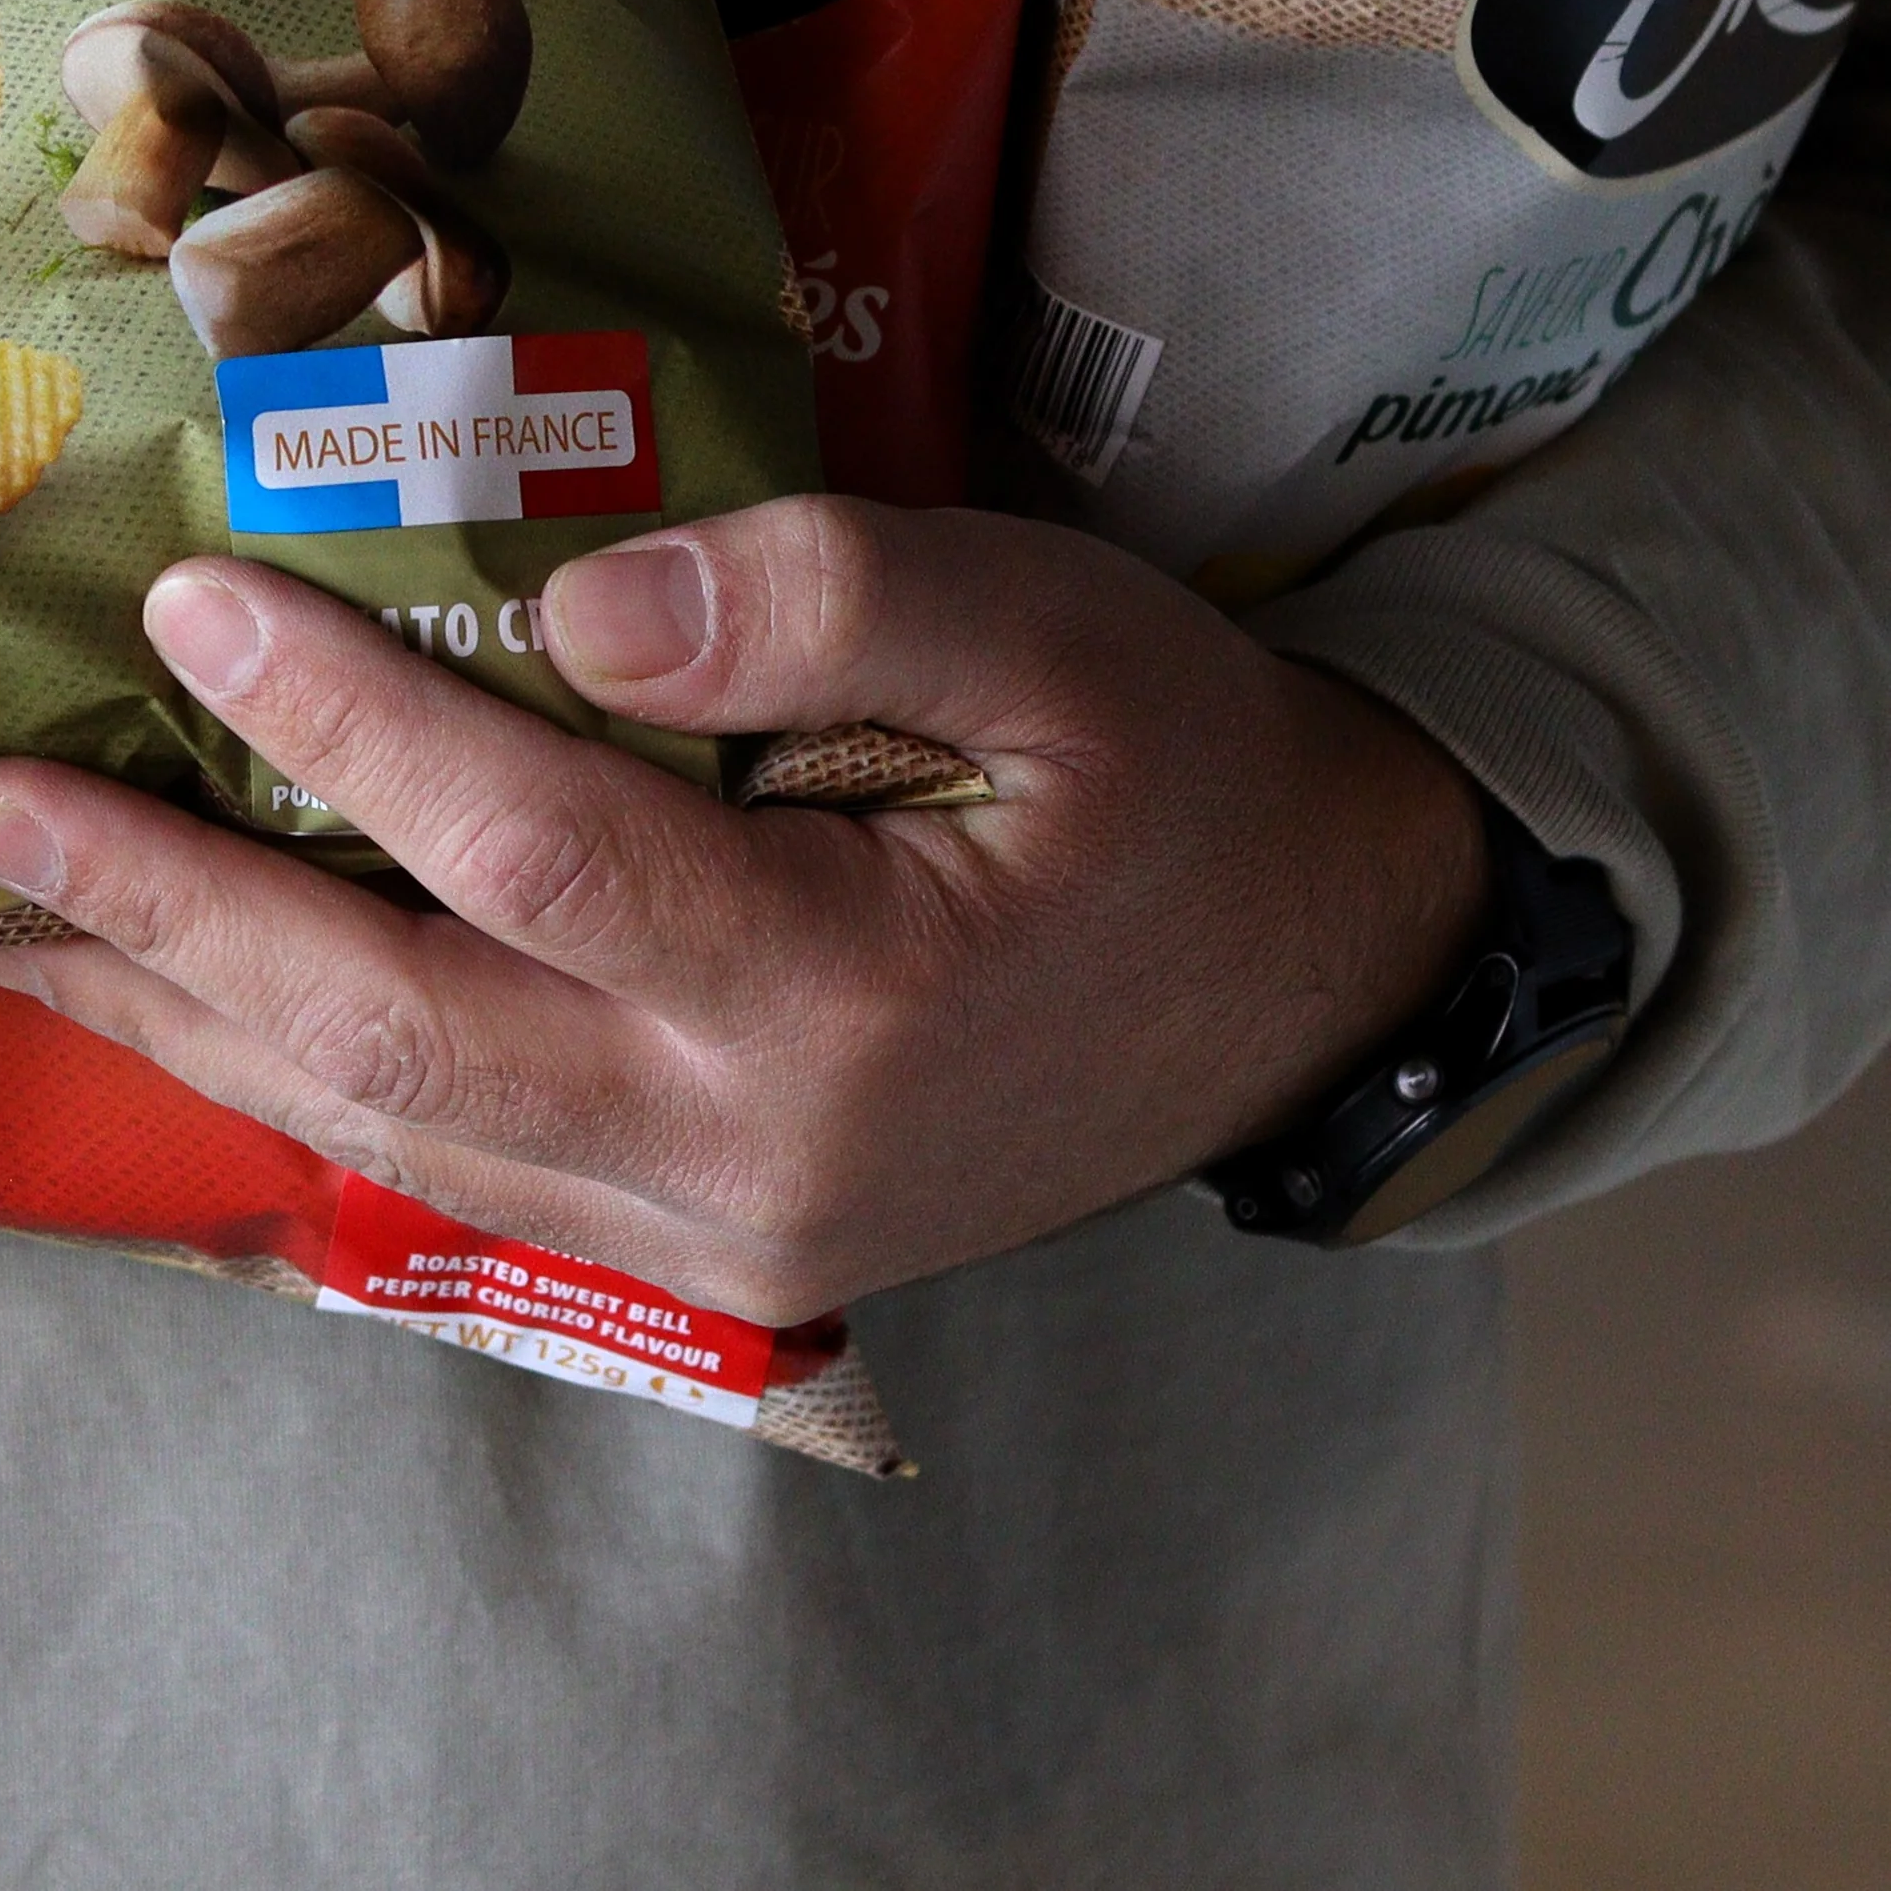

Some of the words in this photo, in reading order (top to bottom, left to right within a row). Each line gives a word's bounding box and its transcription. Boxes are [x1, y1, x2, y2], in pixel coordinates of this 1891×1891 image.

[274, 422, 406, 471] MADE
[416, 418, 460, 460] IN
[472, 410, 618, 457] FRANCE
[365, 1274, 472, 1299] PEPPER
[475, 1285, 596, 1331] CHORIZO
[599, 1320, 723, 1374] FLAVOUR
[407, 1252, 530, 1288] ROASTED
[533, 1276, 625, 1316] SWEET
[627, 1302, 693, 1336] BELL
[458, 1322, 526, 1354] WT
[534, 1337, 630, 1388] 125g
